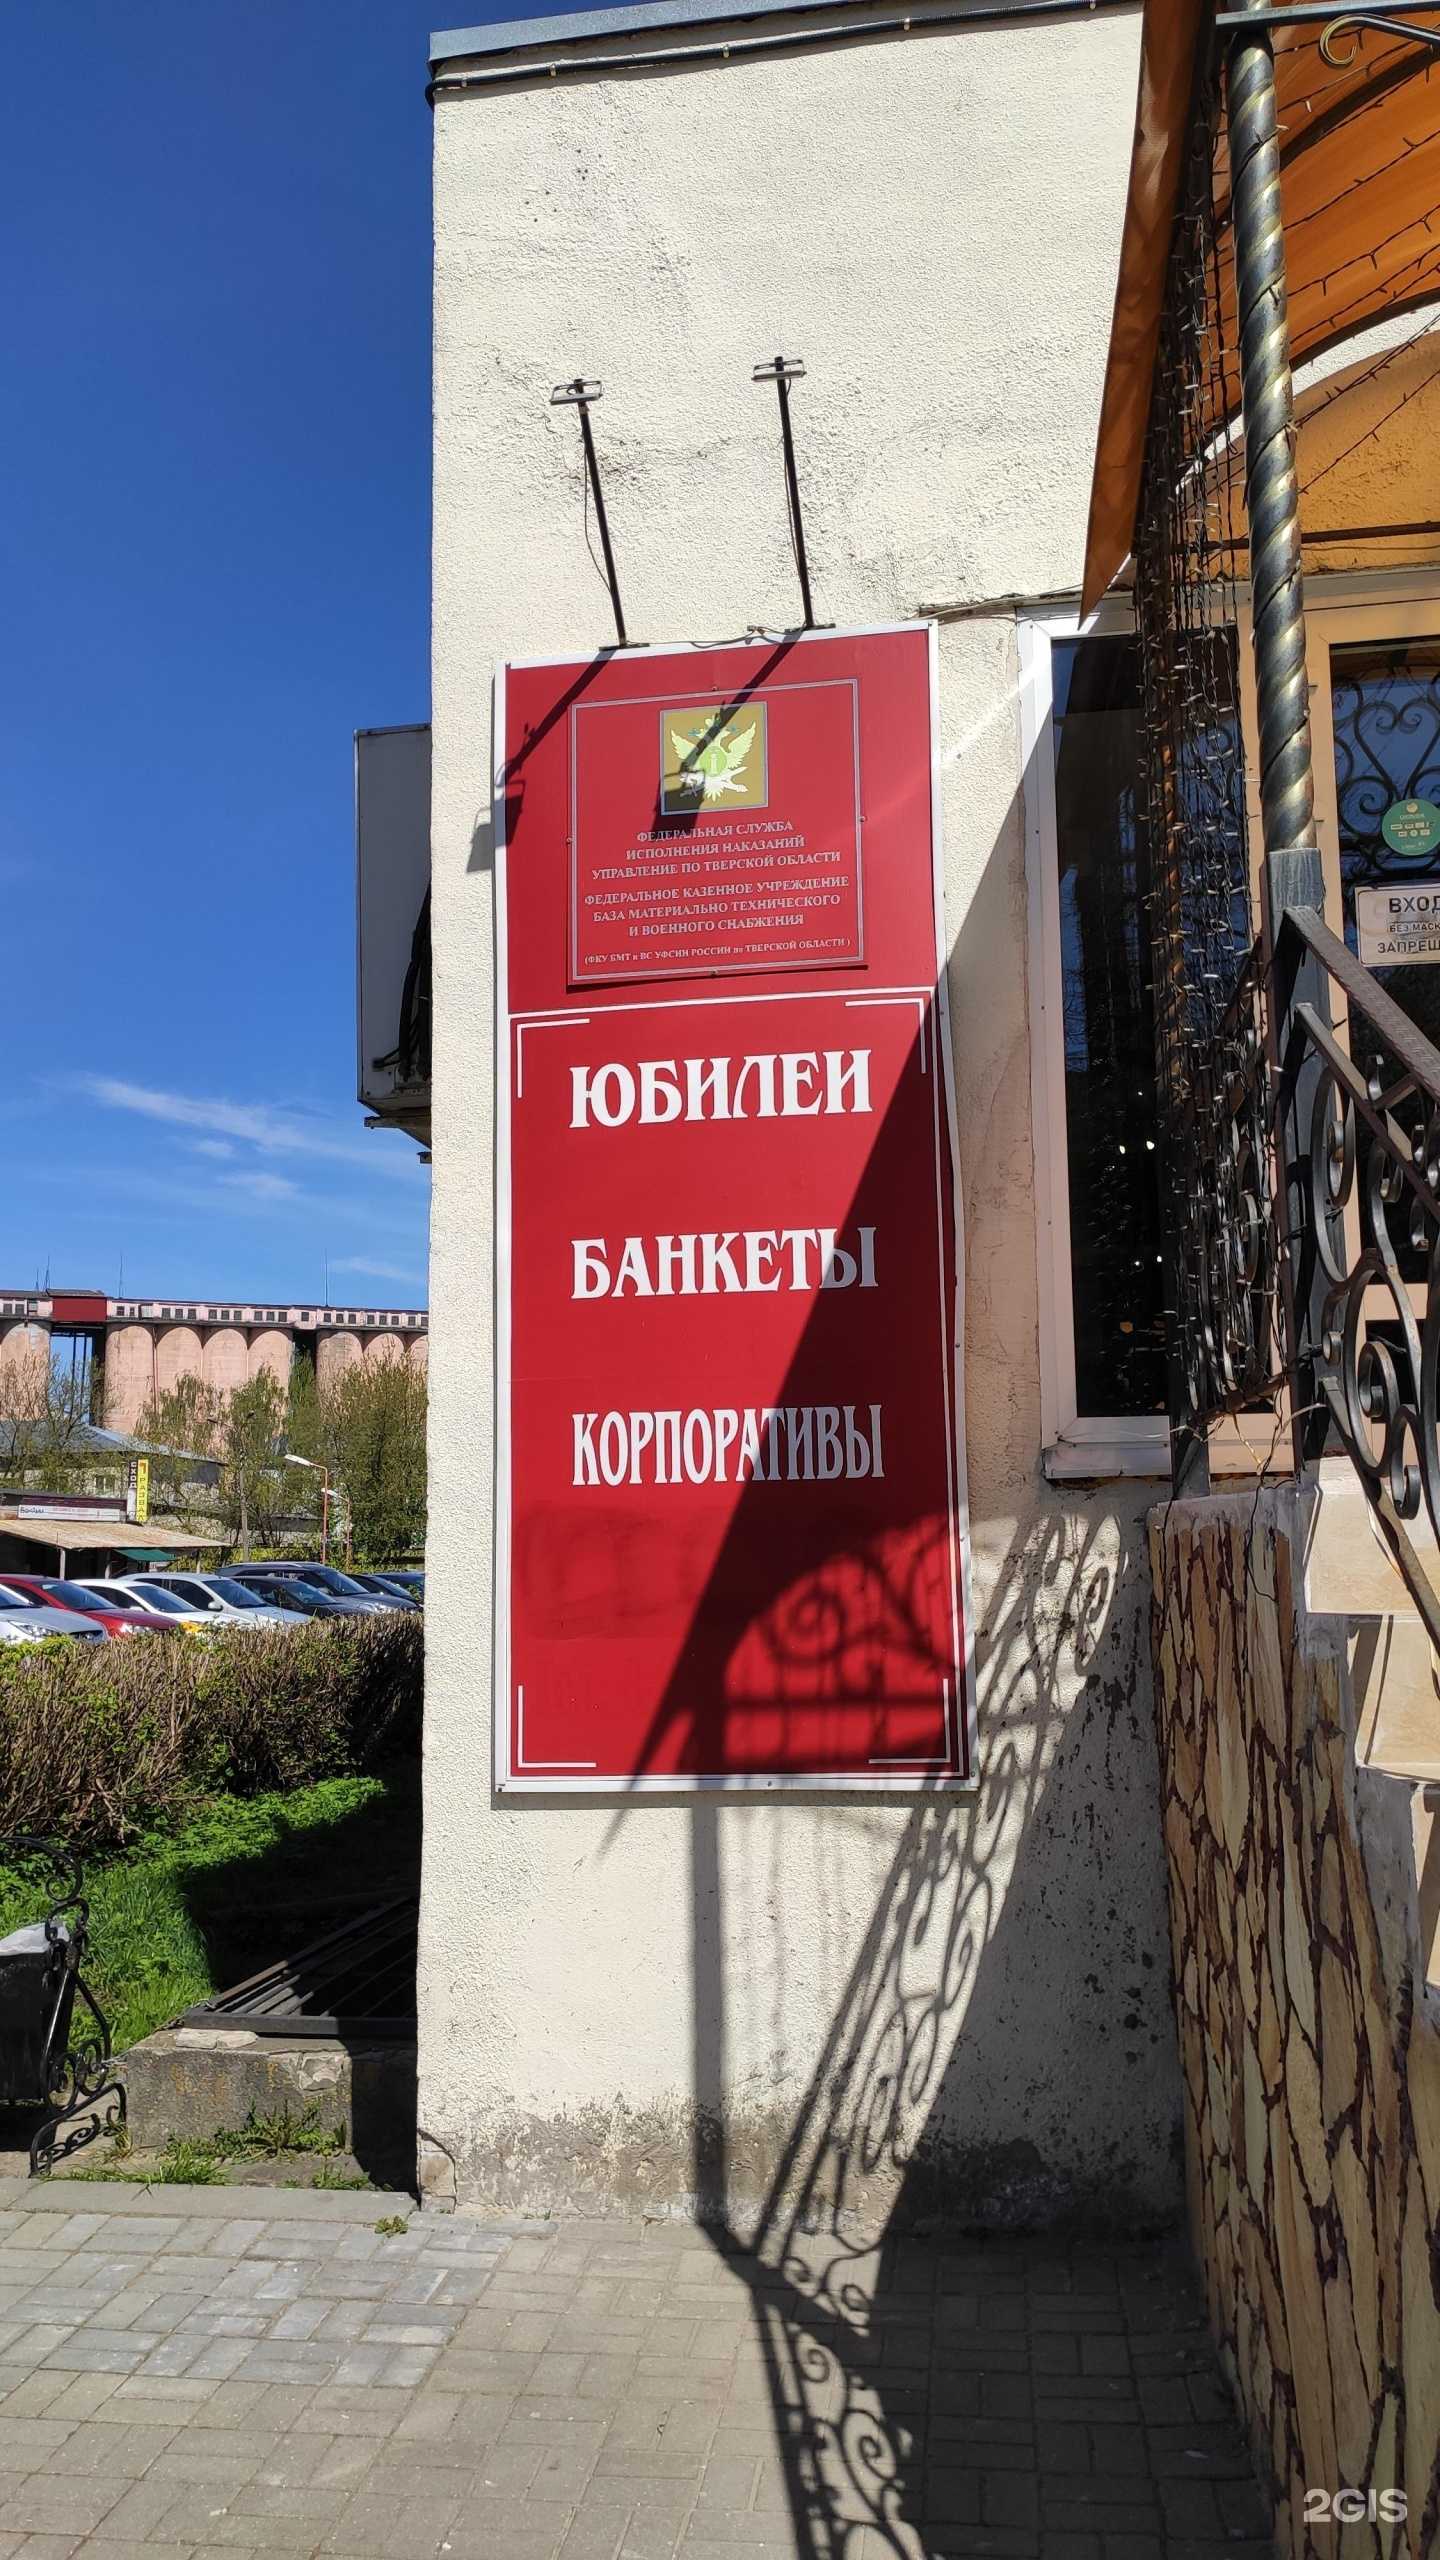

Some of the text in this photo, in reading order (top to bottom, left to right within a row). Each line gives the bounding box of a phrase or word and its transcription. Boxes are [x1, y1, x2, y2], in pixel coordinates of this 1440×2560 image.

[637, 820, 793, 842] ФЕДЕРАЛЬНАЯ СЛУЖБА
[626, 834, 805, 860] ИСПОЛНЕНИЯ НАКАЗАНИЙ
[592, 850, 841, 880] УПРАВЛЕНИЕ ПО ТВЕРСКОЙ ОБЛАСТИ
[585, 876, 849, 905] ФЕДЕРАЛЬНОЕ КАЗЕННОЕ УЧРЕЖДЕНИЕ
[1389, 896, 1440, 913] ВХОД
[593, 894, 840, 922] БАЗА МАТЕРИАЛЬНО ТЕХНИЧЕСКОГО
[629, 913, 804, 937] И ВОЕННОГО СНАБЖЕНИЯ
[610, 952, 631, 962] БМТ
[640, 951, 653, 960] ВС
[655, 948, 689, 959] УФСИН
[691, 945, 731, 956] РОССИИ
[745, 939, 797, 953] ТВЕРСКОЙ
[569, 1049, 873, 1128] ЮБИЛЕИ
[571, 1227, 879, 1300] БАНКЕТЫ
[572, 1405, 885, 1486] КОРПОРАТИВЫ
